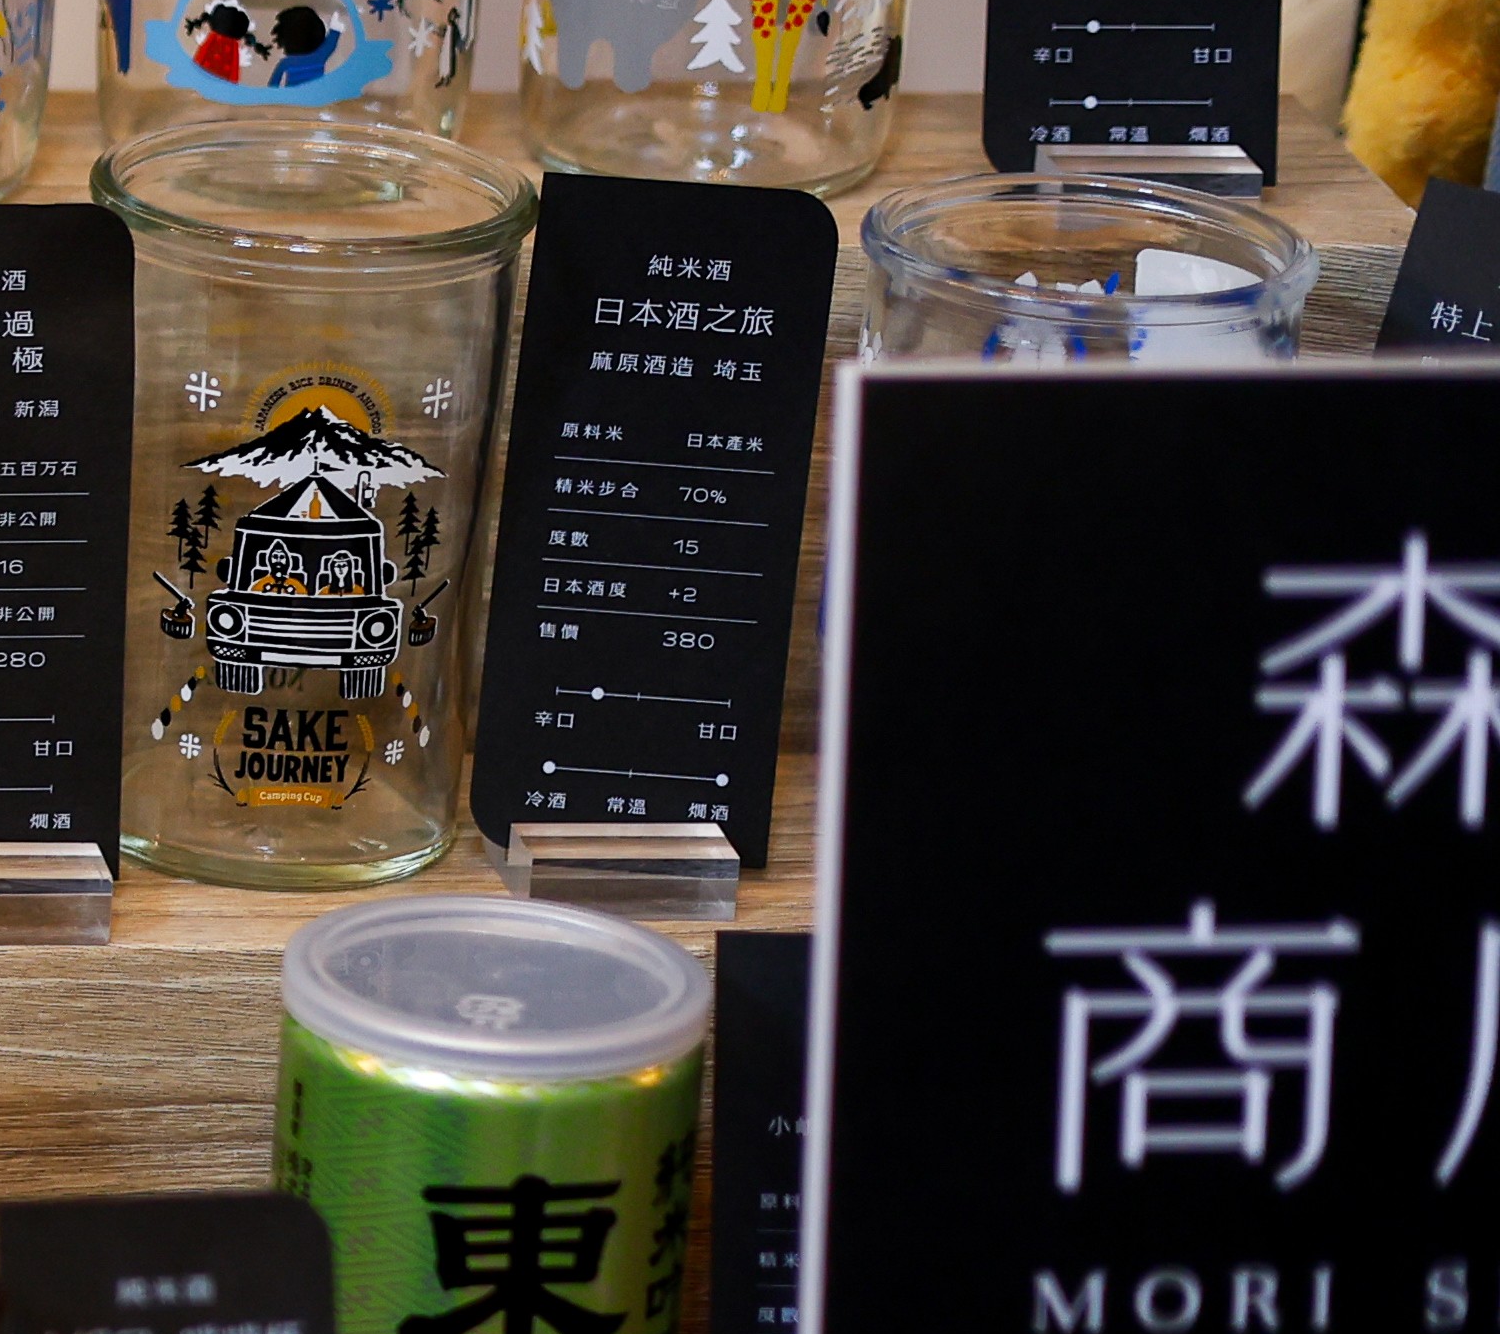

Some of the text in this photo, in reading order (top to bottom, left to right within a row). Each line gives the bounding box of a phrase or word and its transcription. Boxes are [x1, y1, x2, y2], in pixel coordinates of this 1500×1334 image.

[648, 255, 731, 281] 純米酒
[595, 298, 774, 335] 日本酒之旅
[1431, 302, 1492, 341] 特上
[12, 347, 43, 373] 極
[590, 351, 762, 381] 麻原酒造 埼玉
[679, 487, 726, 503] 70%
[663, 631, 714, 649] 380
[242, 707, 349, 751] SAKE
[235, 751, 350, 783] JOURNEY
[1044, 899, 1499, 1192] 商
